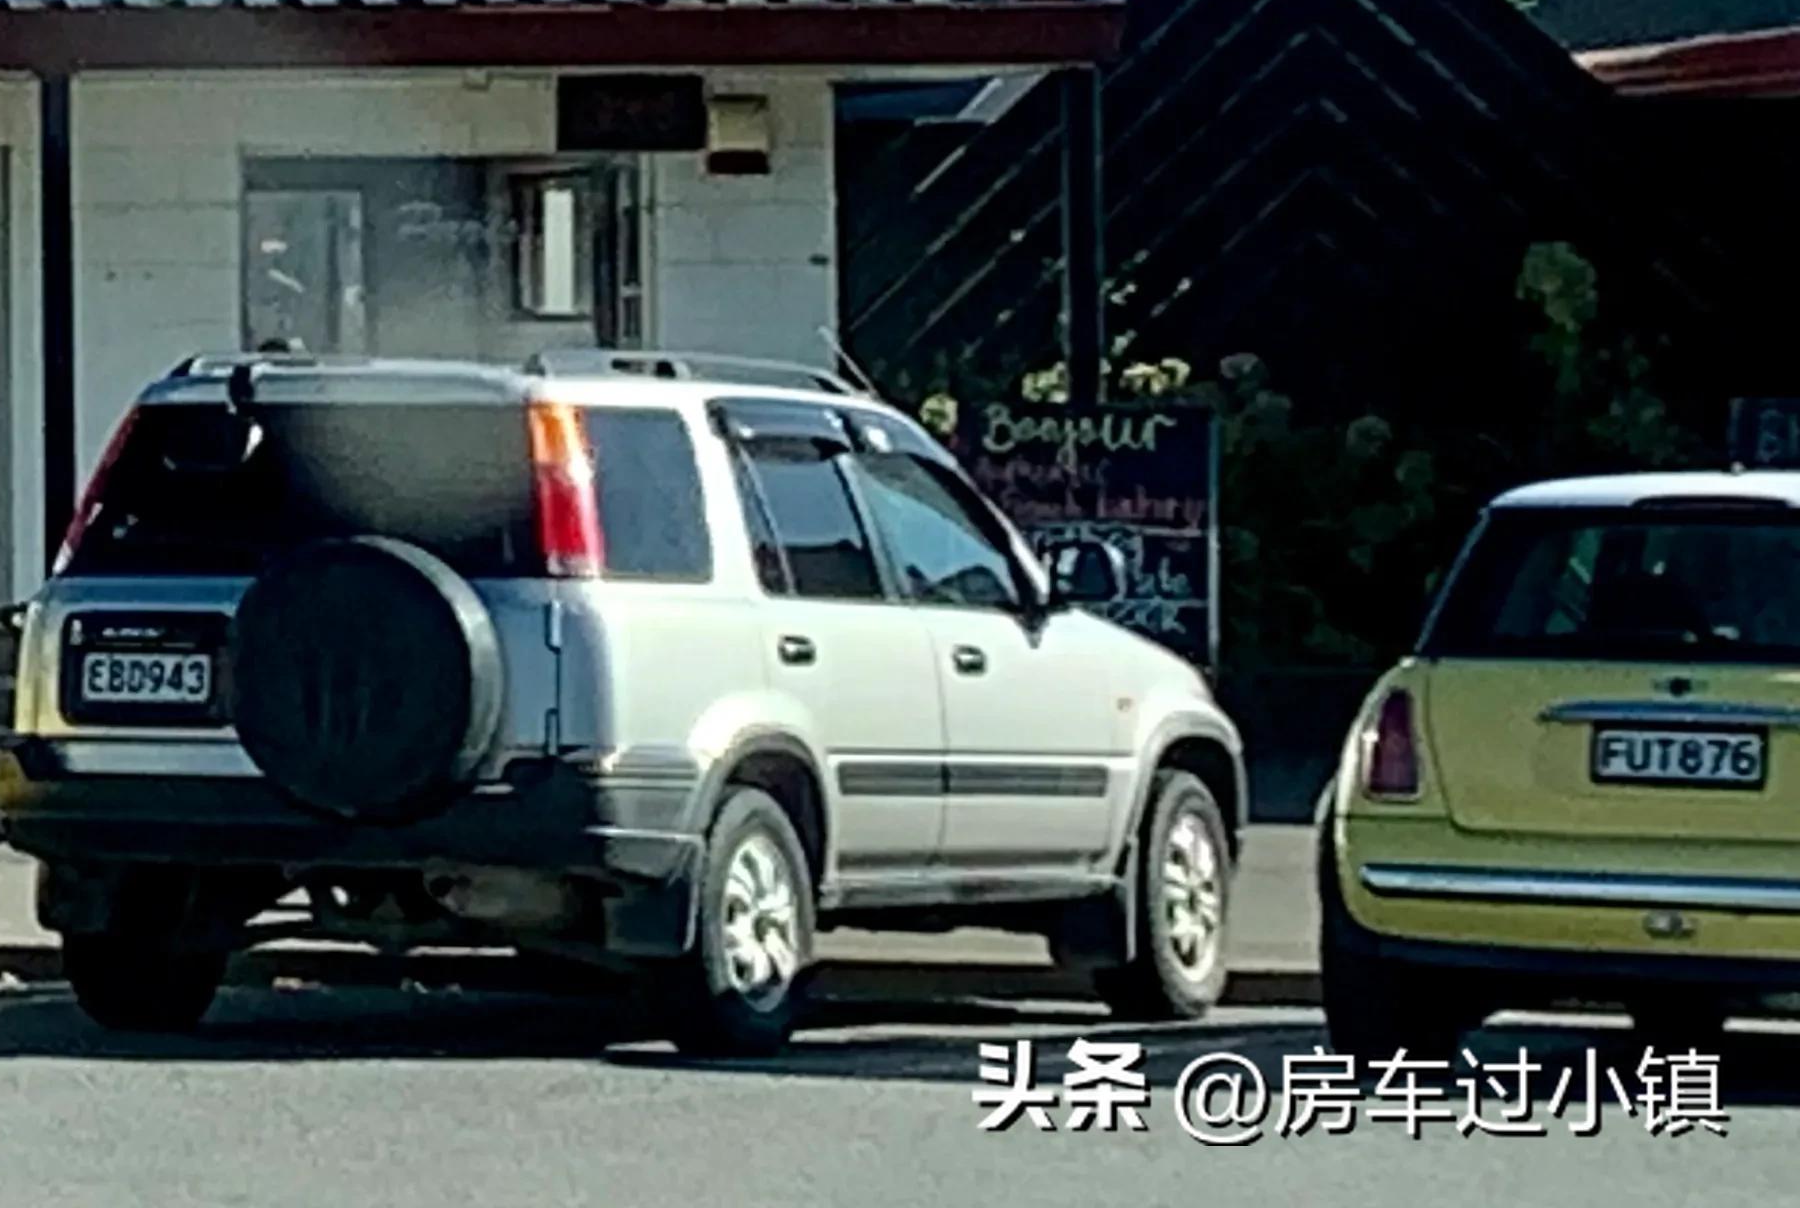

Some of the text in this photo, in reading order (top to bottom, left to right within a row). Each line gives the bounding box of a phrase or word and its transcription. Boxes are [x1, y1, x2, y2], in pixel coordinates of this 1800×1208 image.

[982, 402, 1177, 474] Bonjour
[88, 658, 205, 695] EBD943
[1600, 736, 1757, 776] FUT876
